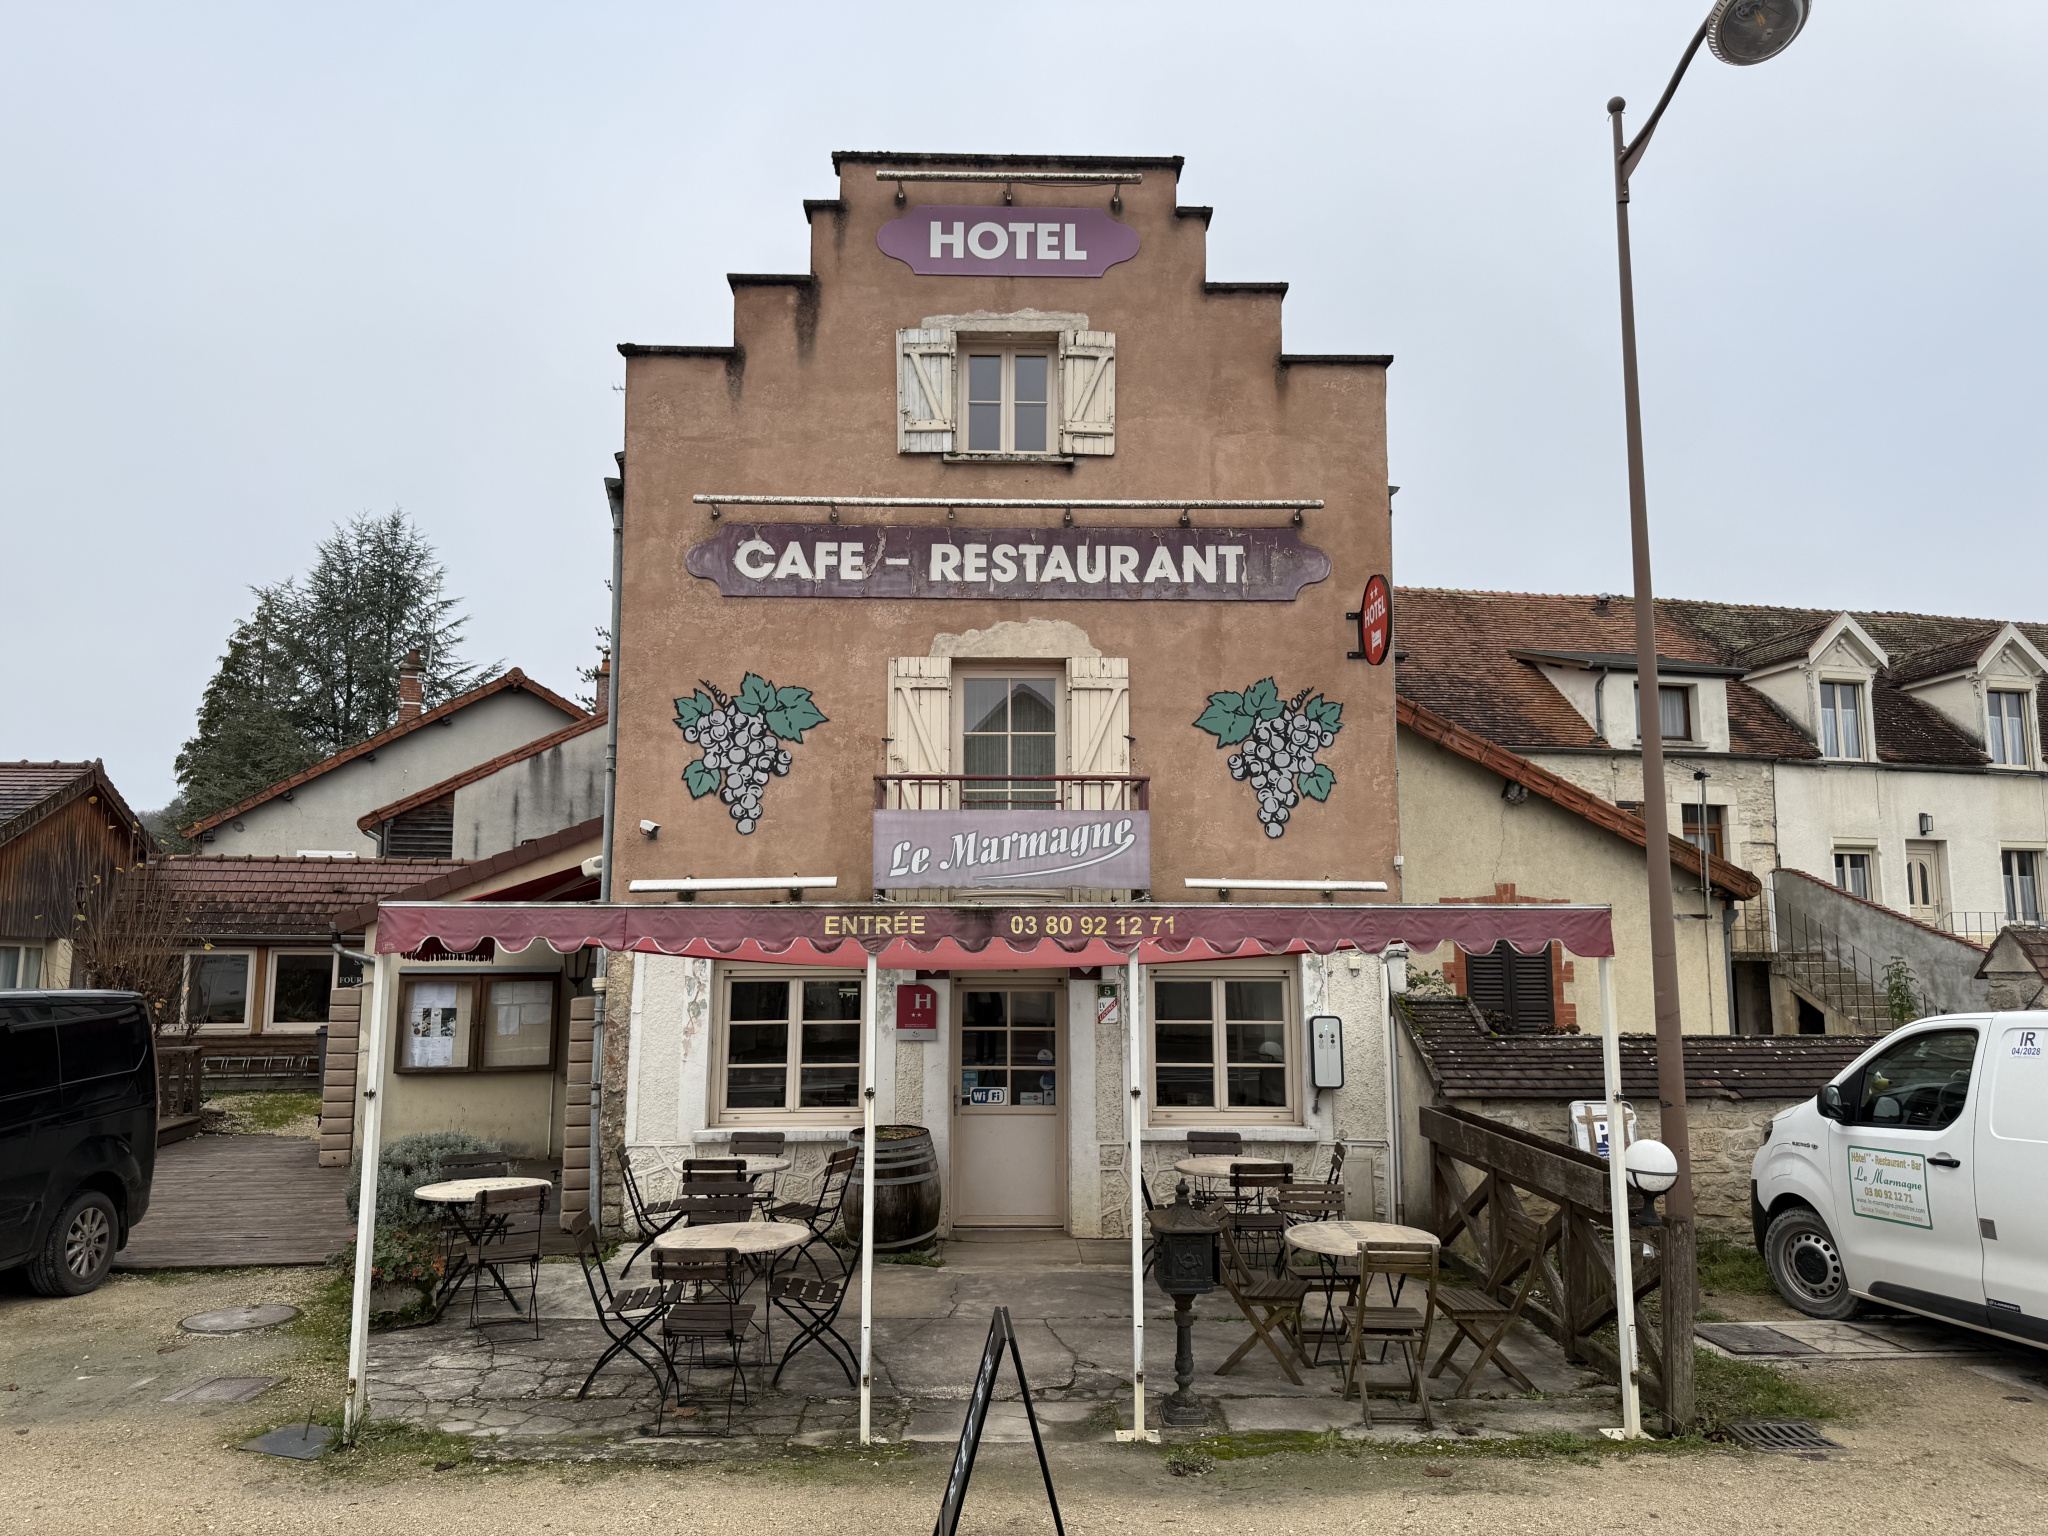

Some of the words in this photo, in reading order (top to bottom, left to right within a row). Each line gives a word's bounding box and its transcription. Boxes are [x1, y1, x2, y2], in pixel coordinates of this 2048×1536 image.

[929, 221, 1087, 260] HOTEL
[734, 540, 864, 580] CAFE
[931, 543, 1244, 584] RESTAURANT
[1364, 595, 1386, 629] HOTEL
[889, 841, 930, 877] Le
[939, 818, 1135, 870] Marmagne
[824, 912, 926, 935] ENTRÉE
[1010, 916, 1037, 934] 03
[1046, 916, 1073, 935] 80
[1080, 916, 1107, 935] 92
[1116, 917, 1143, 935] 12
[1150, 916, 1175, 935] 71
[1104, 987, 1111, 995] 5
[914, 993, 932, 1009] H
[2020, 1032, 2036, 1046] IR
[2011, 1047, 2041, 1056] 04/2028
[973, 1091, 986, 1101] Wi
[991, 1092, 1000, 1101] Fi
[1875, 1155, 1906, 1168] Restaurant
[1911, 1160, 1922, 1170] Bar
[1854, 1165, 1868, 1181] Le
[1869, 1169, 1922, 1191] Marmagne
[1865, 1187, 1873, 1197] 03
[1874, 1188, 1883, 1198] 80
[1884, 1189, 1893, 1200] 92
[1894, 1192, 1903, 1201] 12
[1904, 1193, 1913, 1203] 71
